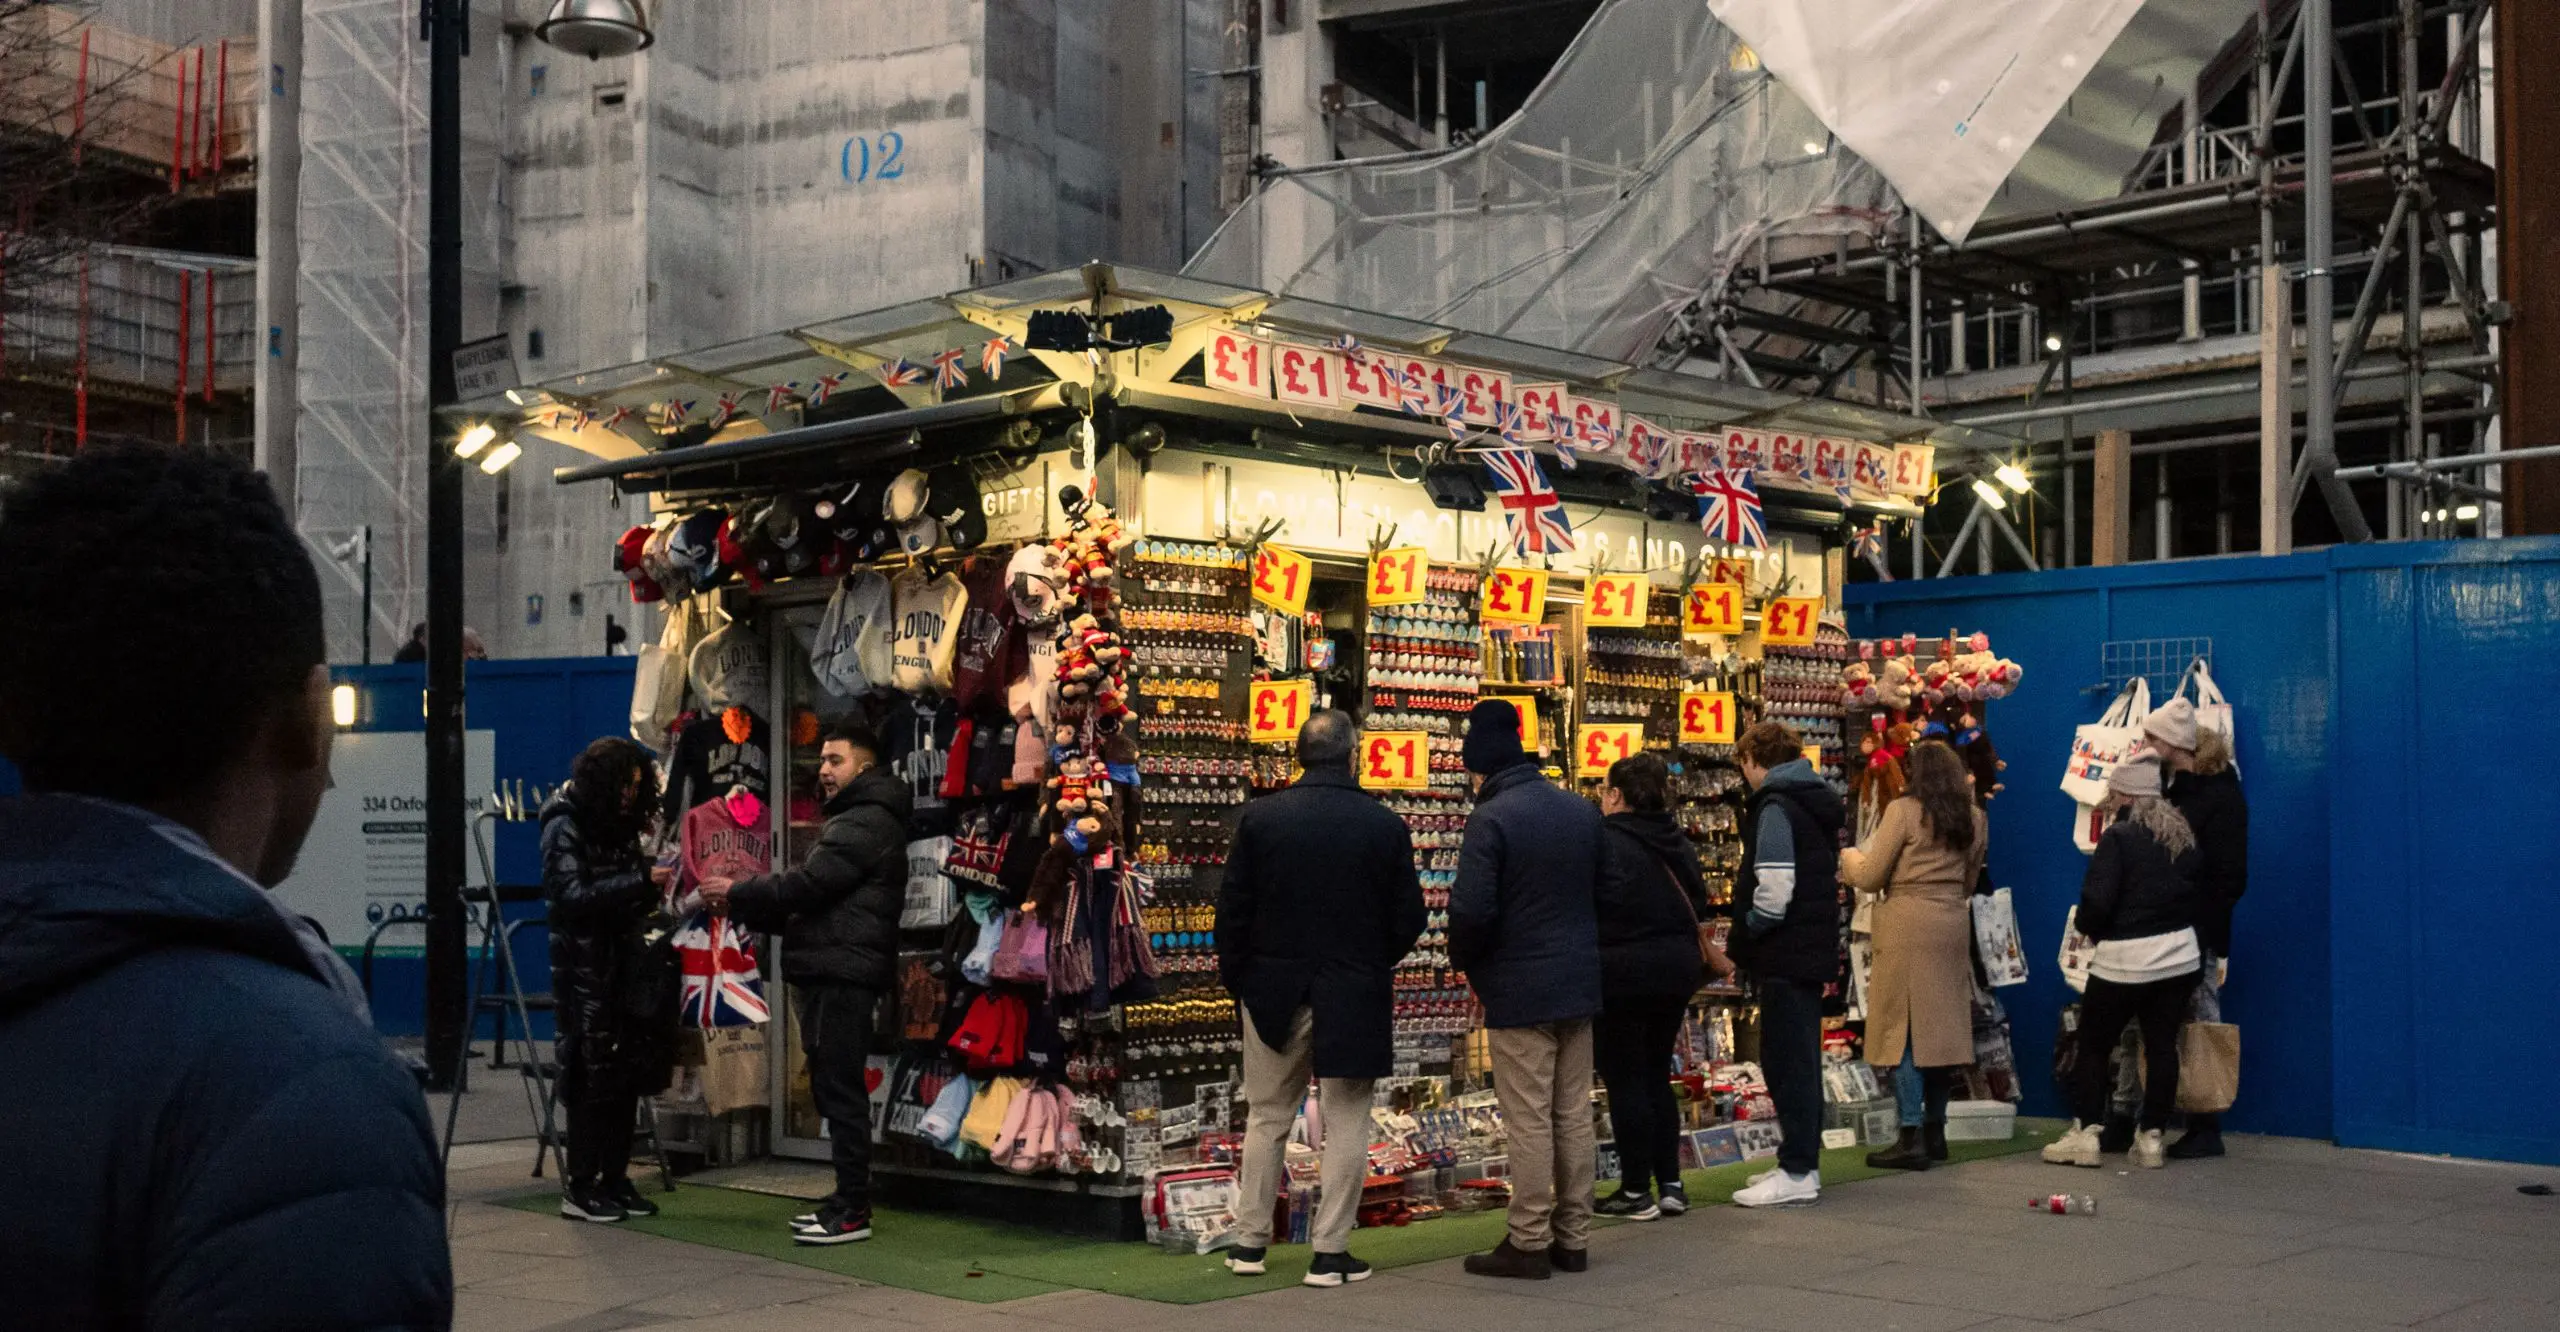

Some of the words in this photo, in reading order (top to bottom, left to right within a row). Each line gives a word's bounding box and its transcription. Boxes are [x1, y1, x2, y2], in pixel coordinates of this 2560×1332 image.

[841, 131, 905, 183] 02
[1213, 335, 1258, 387] £1
[1283, 350, 1328, 397] £1
[1897, 449, 1924, 485] £1
[982, 485, 1044, 517] GIFTS
[1625, 535, 1685, 572] AND
[1254, 550, 1299, 601] £1
[1375, 555, 1415, 595] £1
[1489, 572, 1534, 614] £1
[1591, 580, 1636, 617] £1
[1690, 590, 1732, 625] £1
[1768, 602, 1810, 636] £1
[1254, 689, 1298, 731] £1
[1683, 697, 1724, 734] £1
[1368, 738, 1415, 778] £1
[1586, 730, 1630, 768] £1
[363, 796, 386, 812] 334
[390, 796, 426, 812] Oxfo
